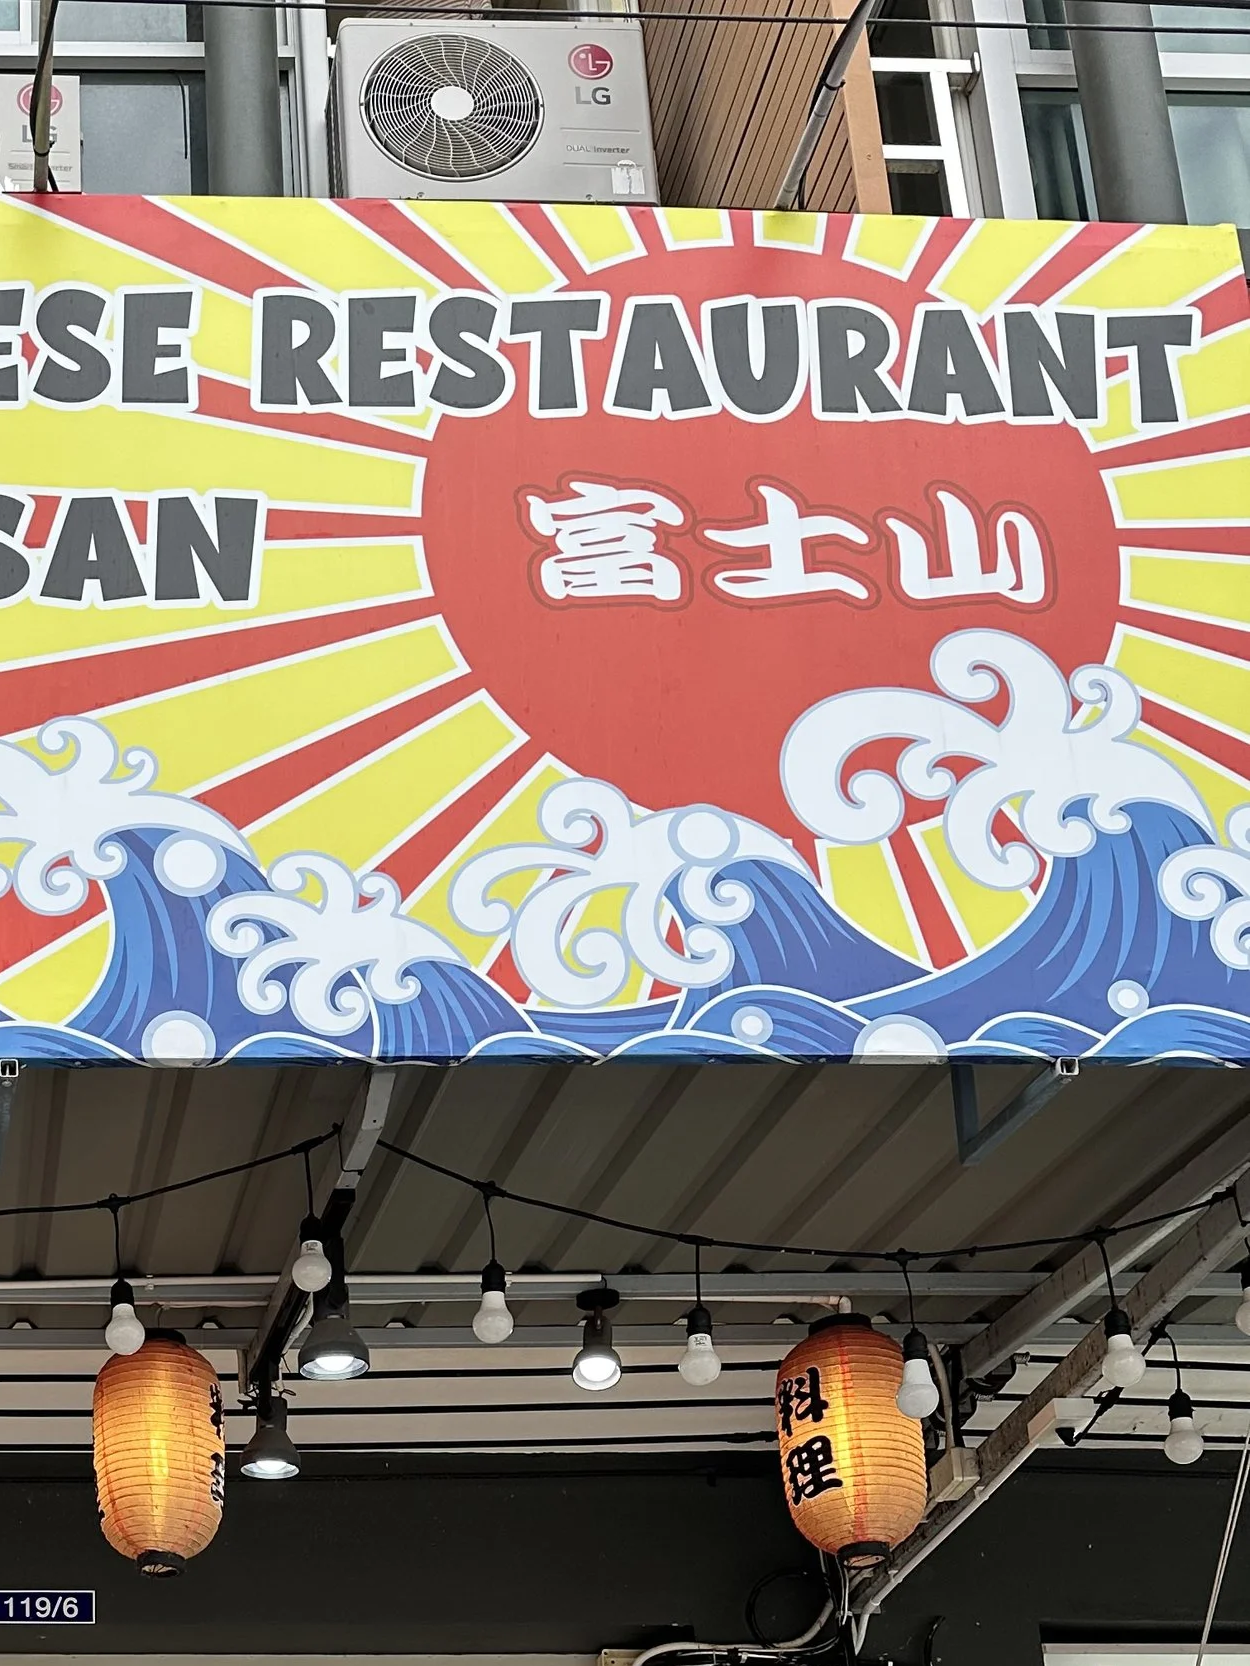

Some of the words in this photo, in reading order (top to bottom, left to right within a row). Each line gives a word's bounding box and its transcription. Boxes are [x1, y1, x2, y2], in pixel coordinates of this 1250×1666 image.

[575, 86, 611, 106] LG
[593, 146, 630, 154] Inverter
[259, 293, 1194, 424] RESTAURANT
[525, 481, 1044, 605] 富士山
[777, 1366, 844, 1507] 料理
[2, 1597, 80, 1620] 119/6
